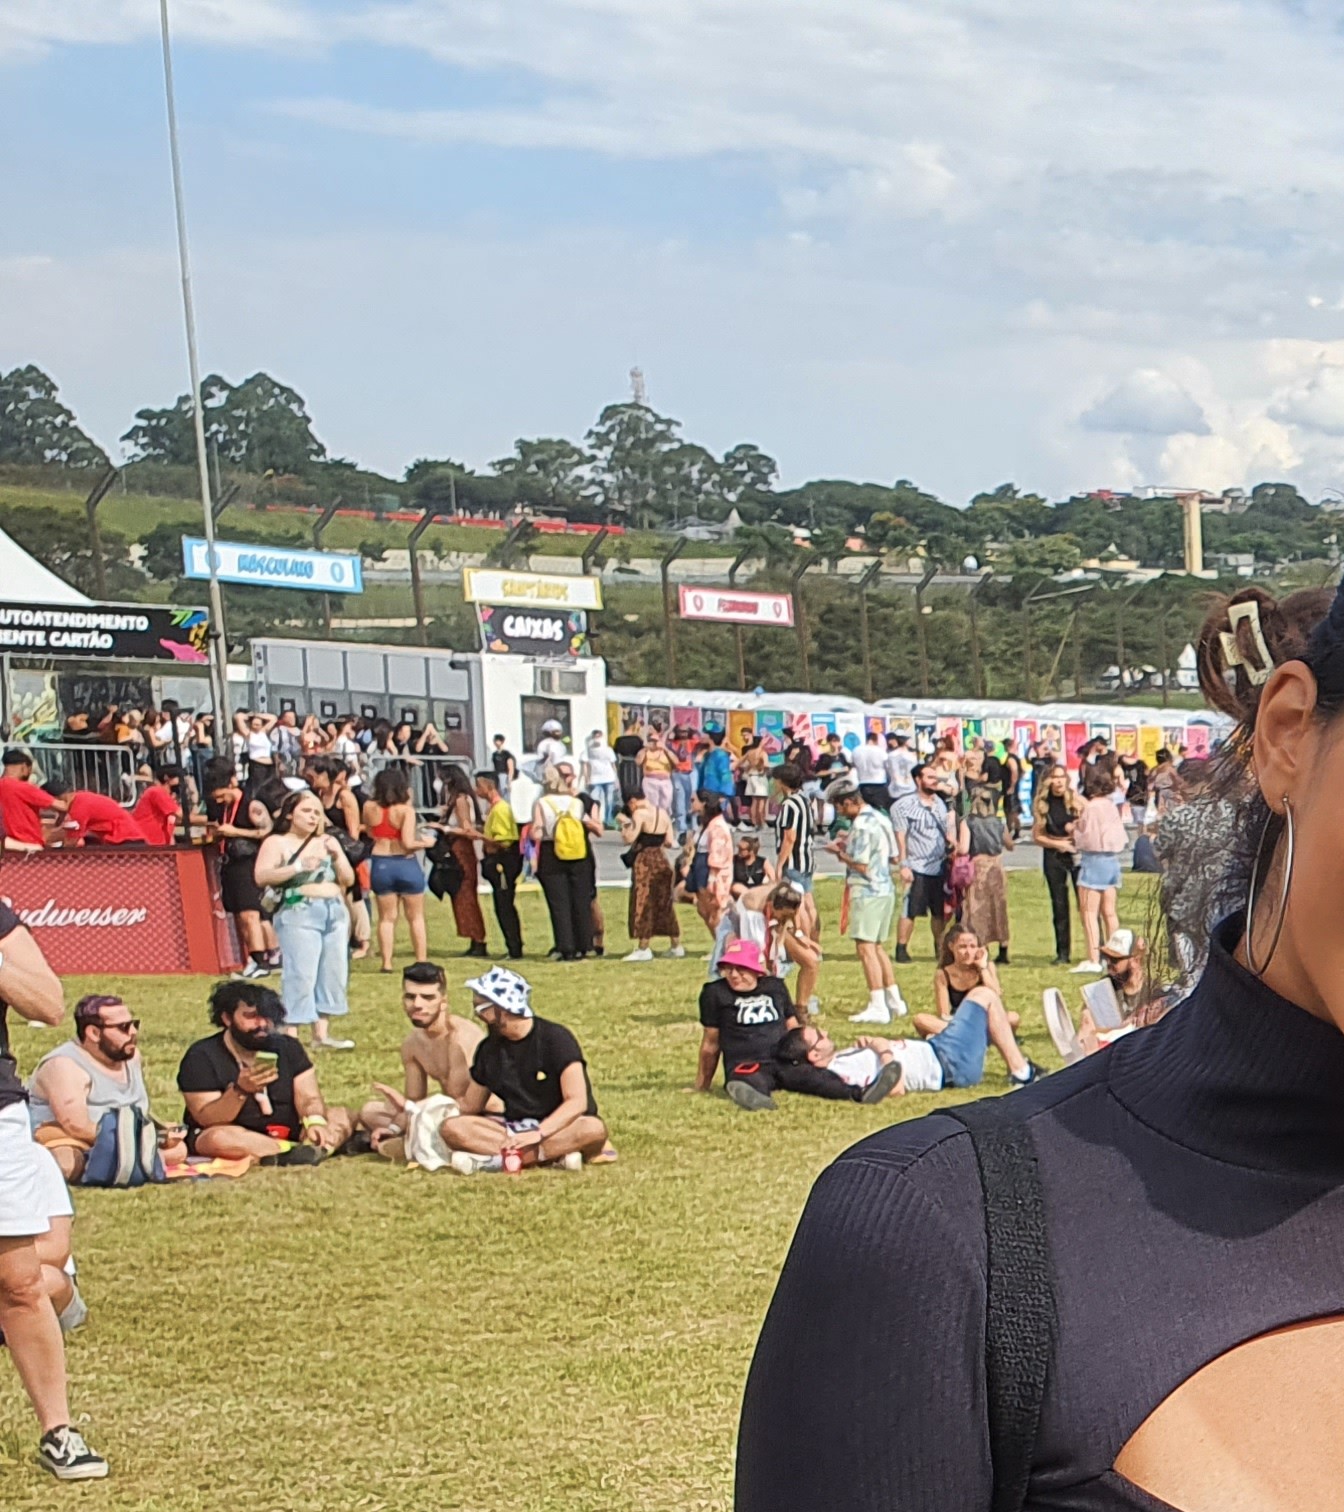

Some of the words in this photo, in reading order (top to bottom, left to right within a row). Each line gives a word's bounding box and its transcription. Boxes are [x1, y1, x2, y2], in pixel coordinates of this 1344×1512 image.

[0, 629, 47, 647] ENTE
[49, 630, 113, 650] CARTÃO
[503, 615, 564, 642] CAIXAS
